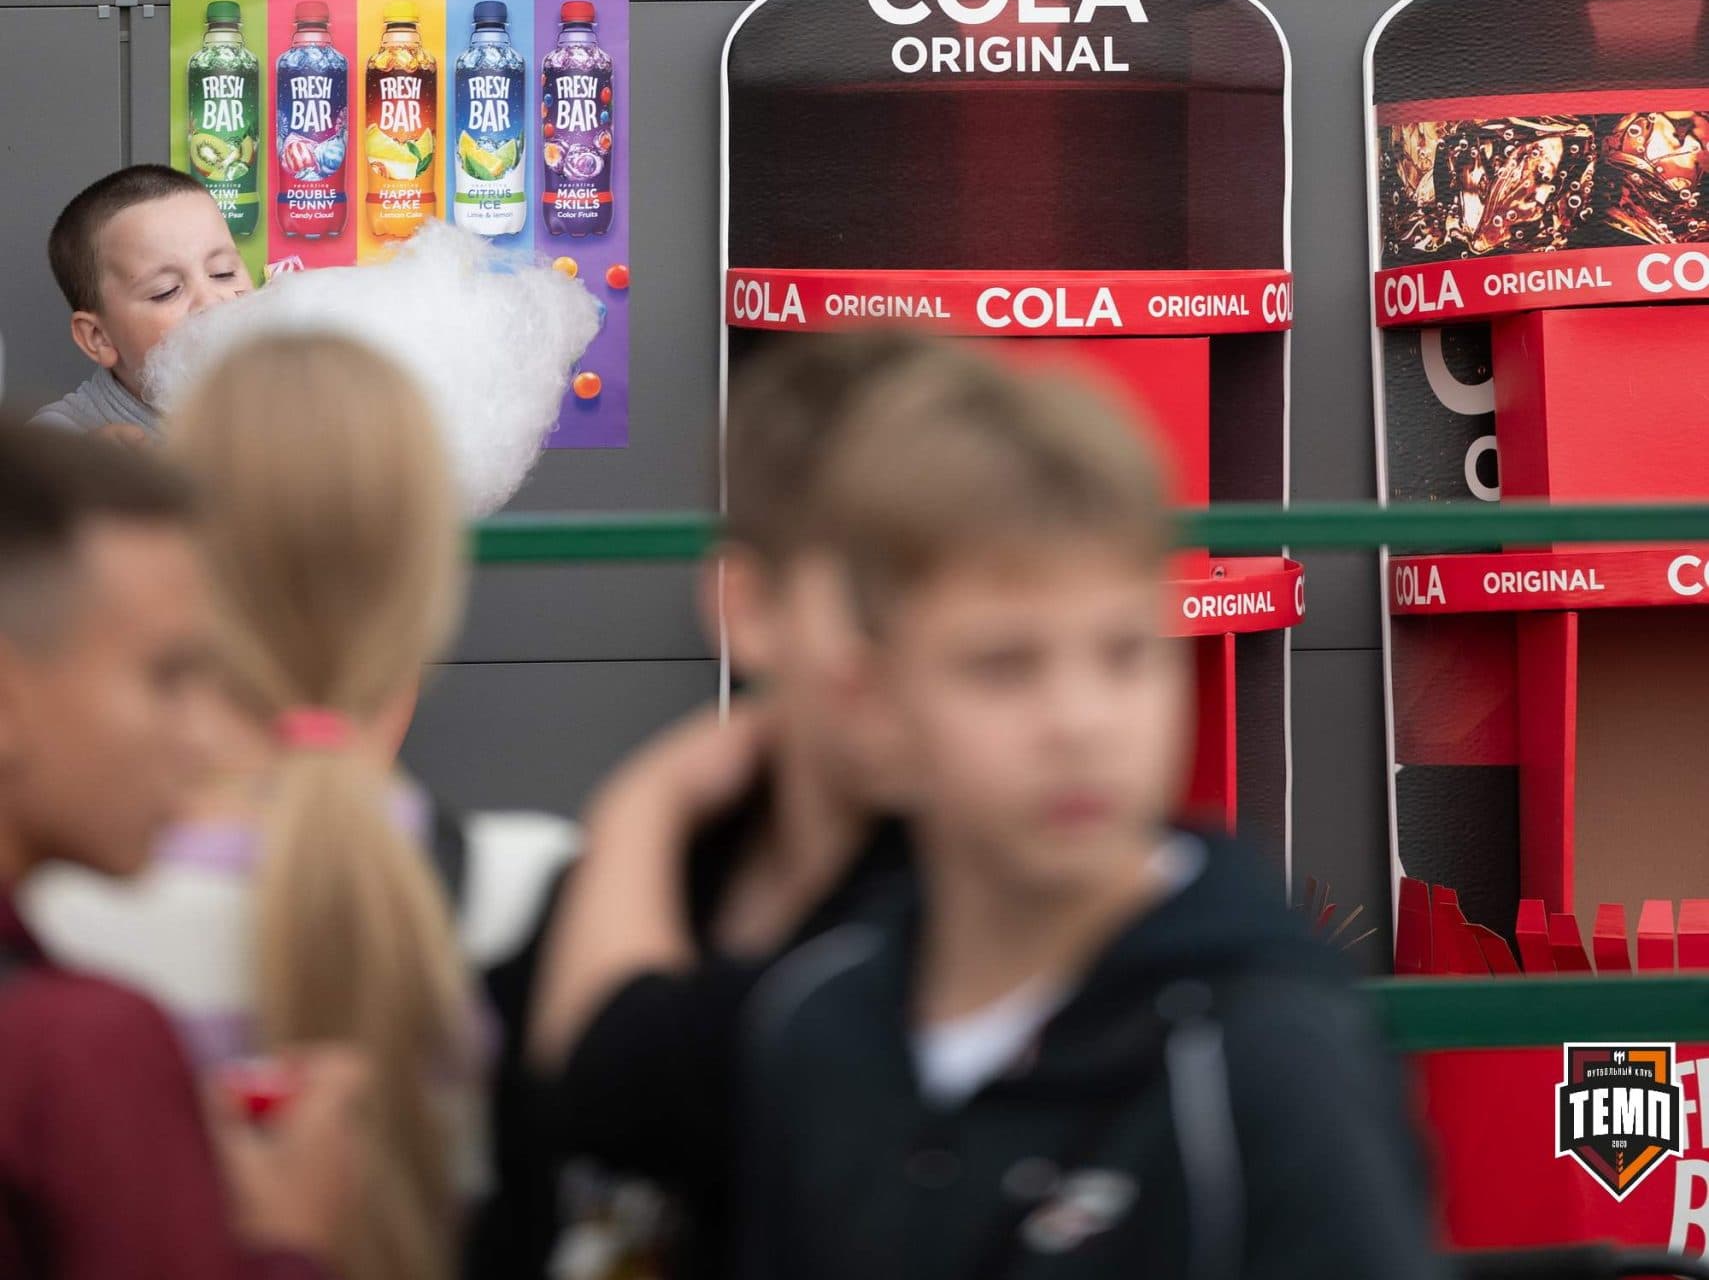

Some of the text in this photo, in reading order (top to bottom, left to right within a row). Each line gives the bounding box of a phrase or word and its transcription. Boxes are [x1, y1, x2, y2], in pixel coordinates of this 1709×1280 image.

[891, 35, 1129, 73] ORIGINAL
[202, 75, 244, 99] FRESH
[290, 75, 332, 99] FRESH
[380, 75, 422, 99] FRESH
[468, 75, 510, 99] FRESH
[556, 75, 598, 99] FRESH
[202, 99, 245, 133] BAR
[290, 99, 333, 133] BAR
[380, 99, 423, 133] BAR
[468, 99, 511, 133] BAR
[556, 99, 599, 133] BAR
[287, 189, 336, 199] DOUBLE
[289, 200, 334, 210] FUNNY
[379, 189, 422, 199] HAPPY
[382, 199, 421, 210] CAKE
[468, 189, 512, 198] CITRUS
[479, 200, 501, 210] ICE
[554, 199, 600, 210] SKILLS
[557, 188, 599, 198] MAGIC
[290, 212, 313, 220] Candy
[733, 279, 806, 324] COLA
[825, 294, 950, 318] ORIGINAL
[976, 287, 1123, 328] COLA
[1148, 294, 1250, 318] ORIGINAL
[1384, 270, 1464, 318] COLA
[1483, 266, 1612, 296] ORIGINAL
[1396, 565, 1605, 606] COLA ORIGINAL
[1182, 591, 1275, 619] ORIGINAL
